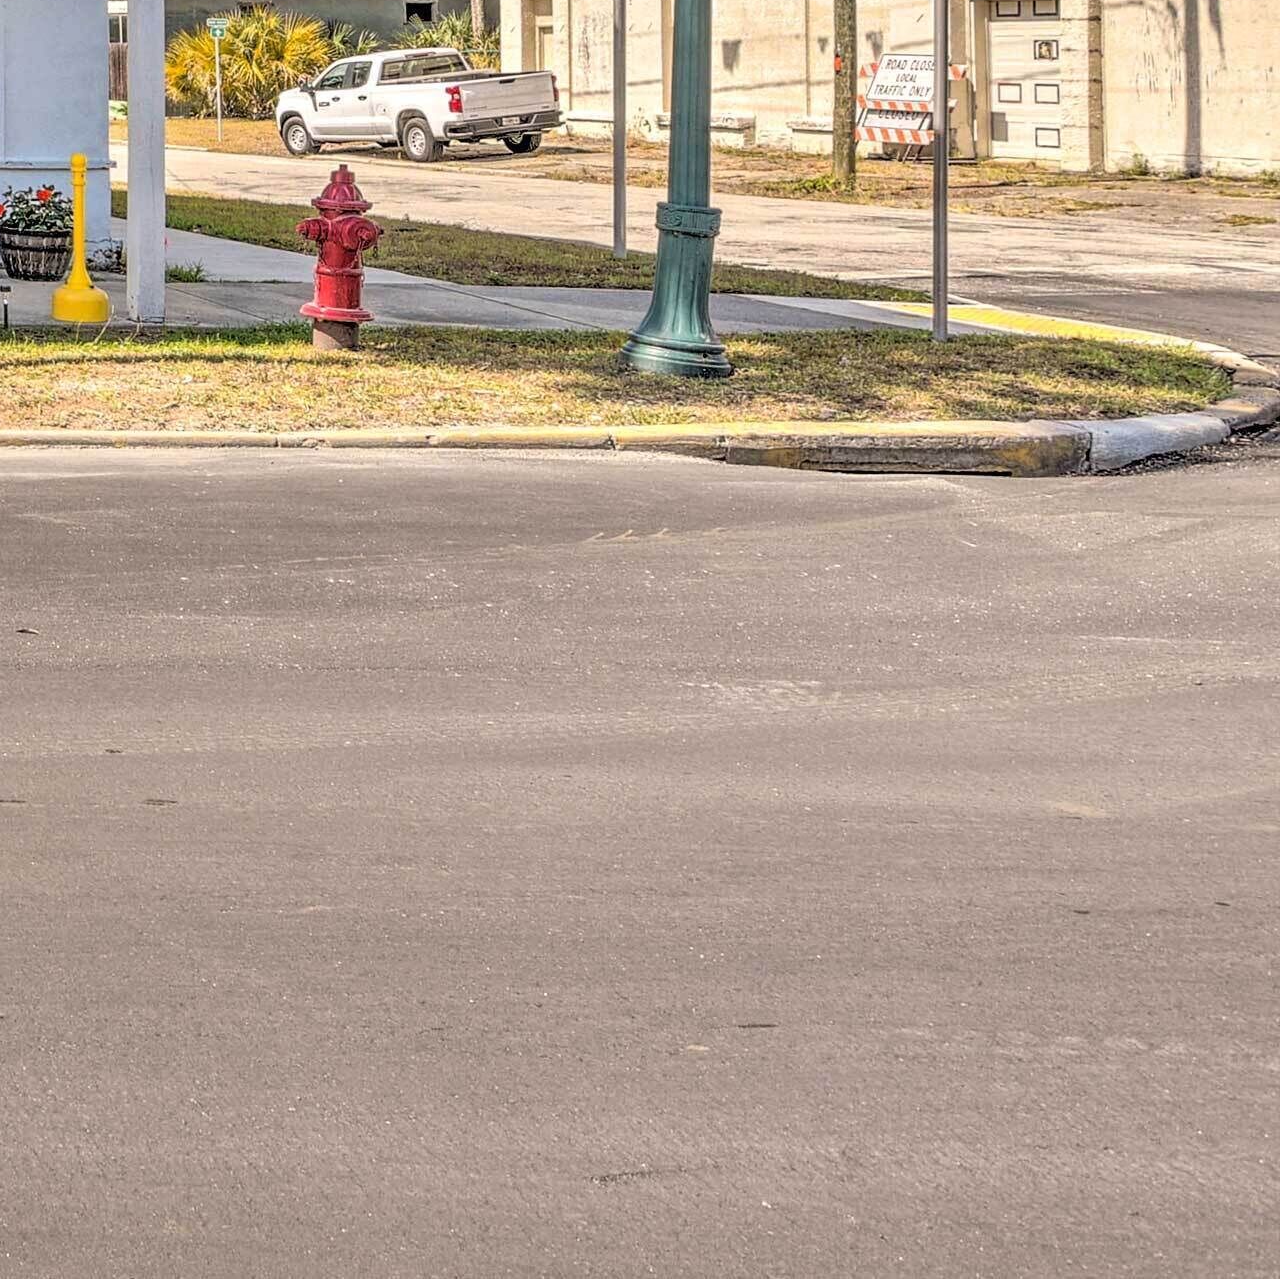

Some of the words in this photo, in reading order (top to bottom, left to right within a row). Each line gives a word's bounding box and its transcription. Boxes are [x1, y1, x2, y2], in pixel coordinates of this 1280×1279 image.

[885, 59, 907, 70] ROAD
[896, 73, 917, 83] LOCAL
[874, 84, 907, 96] TRAFFIC
[909, 86, 931, 97] ONLY
